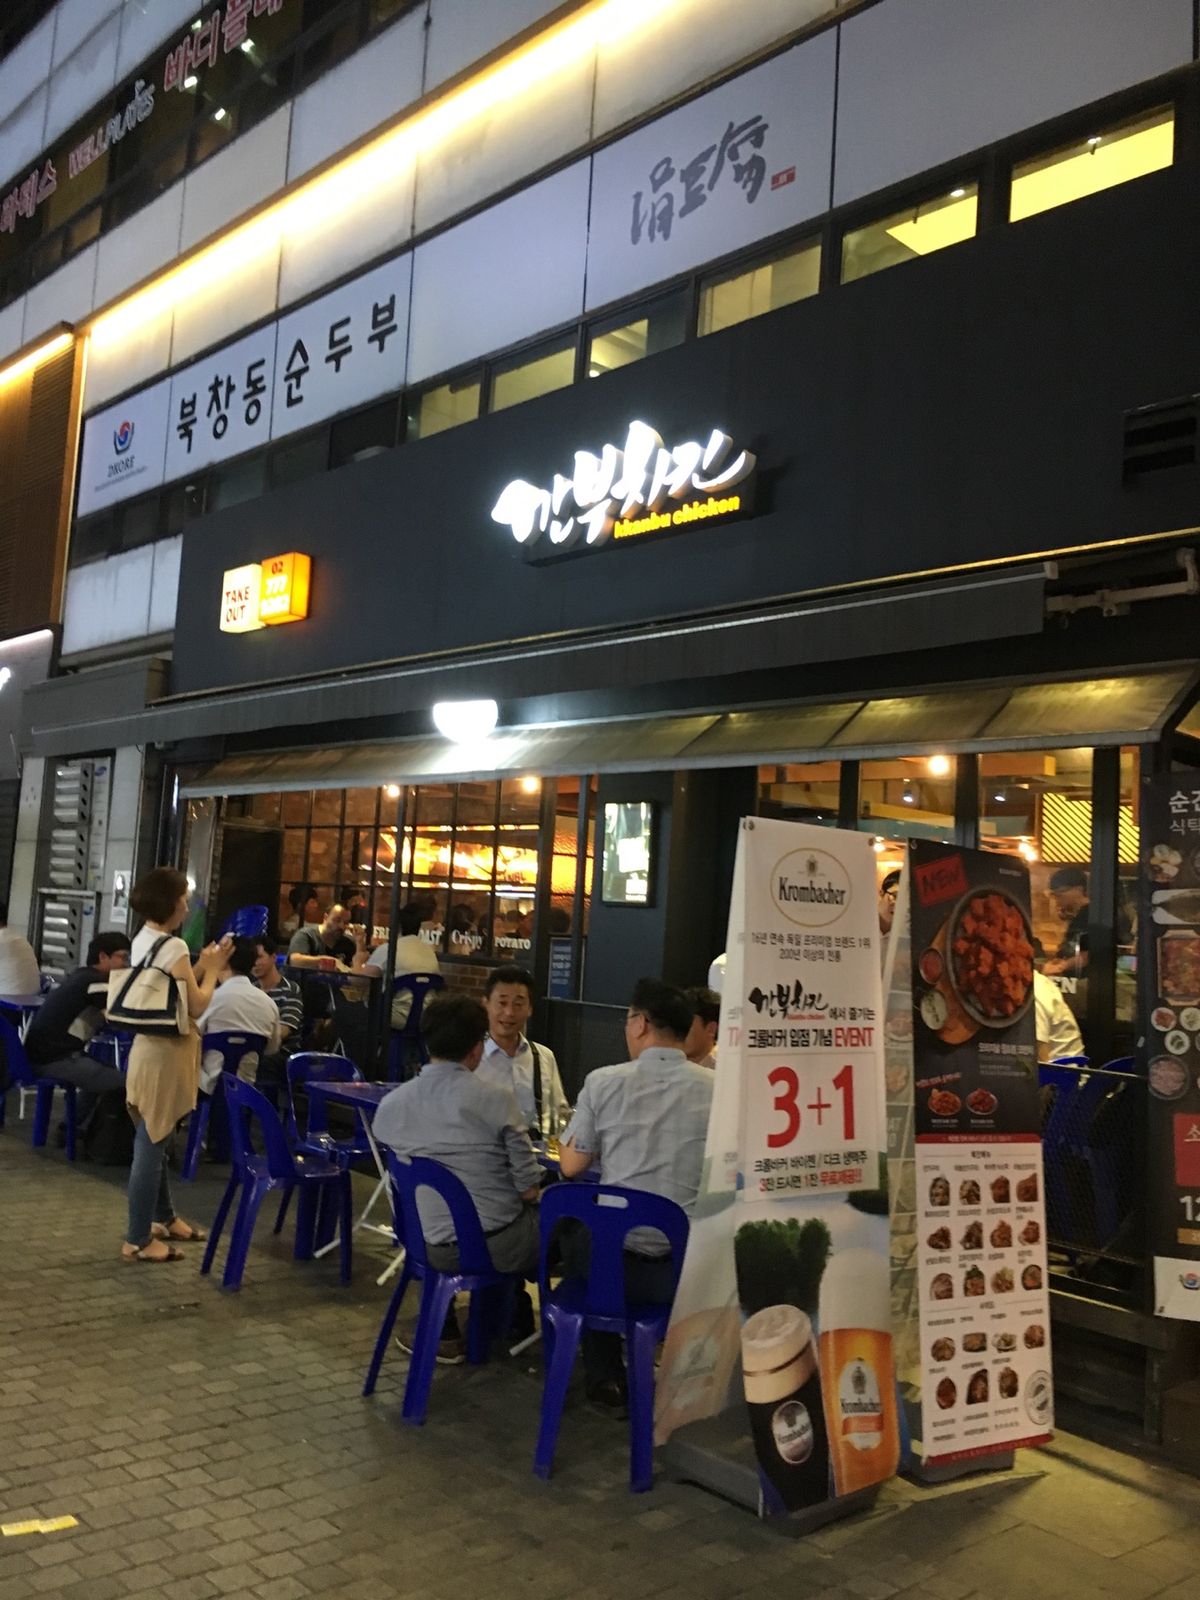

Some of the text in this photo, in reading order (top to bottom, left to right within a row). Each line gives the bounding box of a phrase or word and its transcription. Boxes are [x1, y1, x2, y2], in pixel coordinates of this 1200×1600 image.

[672, 496, 740, 525] chicken
[225, 585, 250, 605] TAKE
[225, 604, 246, 623] OUT
[778, 876, 846, 906] Krombacher
[451, 929, 483, 950] Crispy
[494, 936, 532, 950] POTATO
[789, 1028, 810, 1048] 입점
[812, 1028, 833, 1048] 기념
[834, 1026, 875, 1048] EVENT
